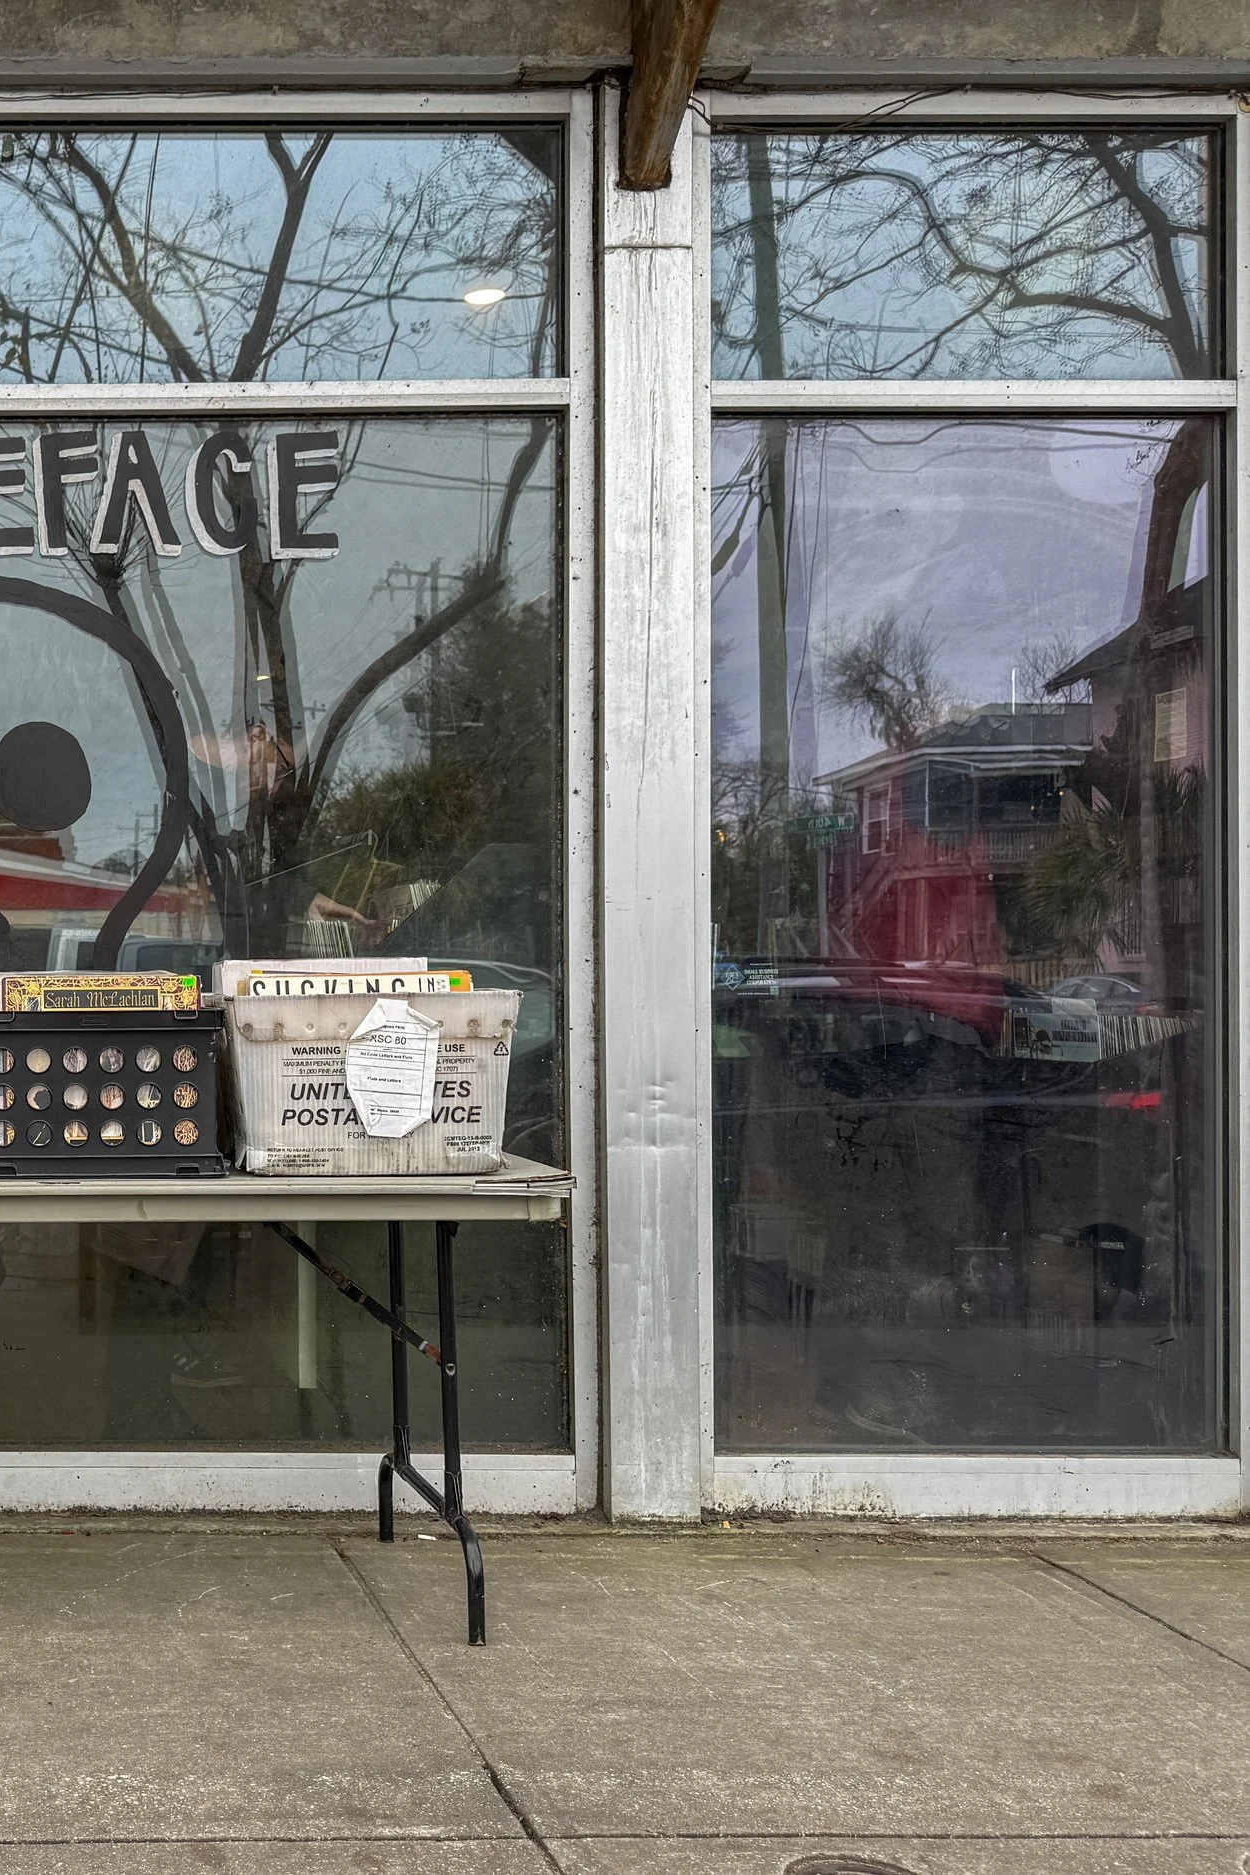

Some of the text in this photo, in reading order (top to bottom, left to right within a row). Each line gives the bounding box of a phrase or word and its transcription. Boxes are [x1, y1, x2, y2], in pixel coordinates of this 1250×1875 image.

[44, 989, 156, 1008] Sarah McLachlan
[394, 1035, 407, 1045] 80
[291, 1046, 341, 1056] WARNING
[444, 1043, 466, 1053] USE
[442, 1057, 476, 1065] PROPERTY
[432, 1080, 472, 1098] TES
[281, 1107, 363, 1127] POSTA
[430, 1105, 483, 1124] VICE
[347, 1131, 366, 1139] FOR
